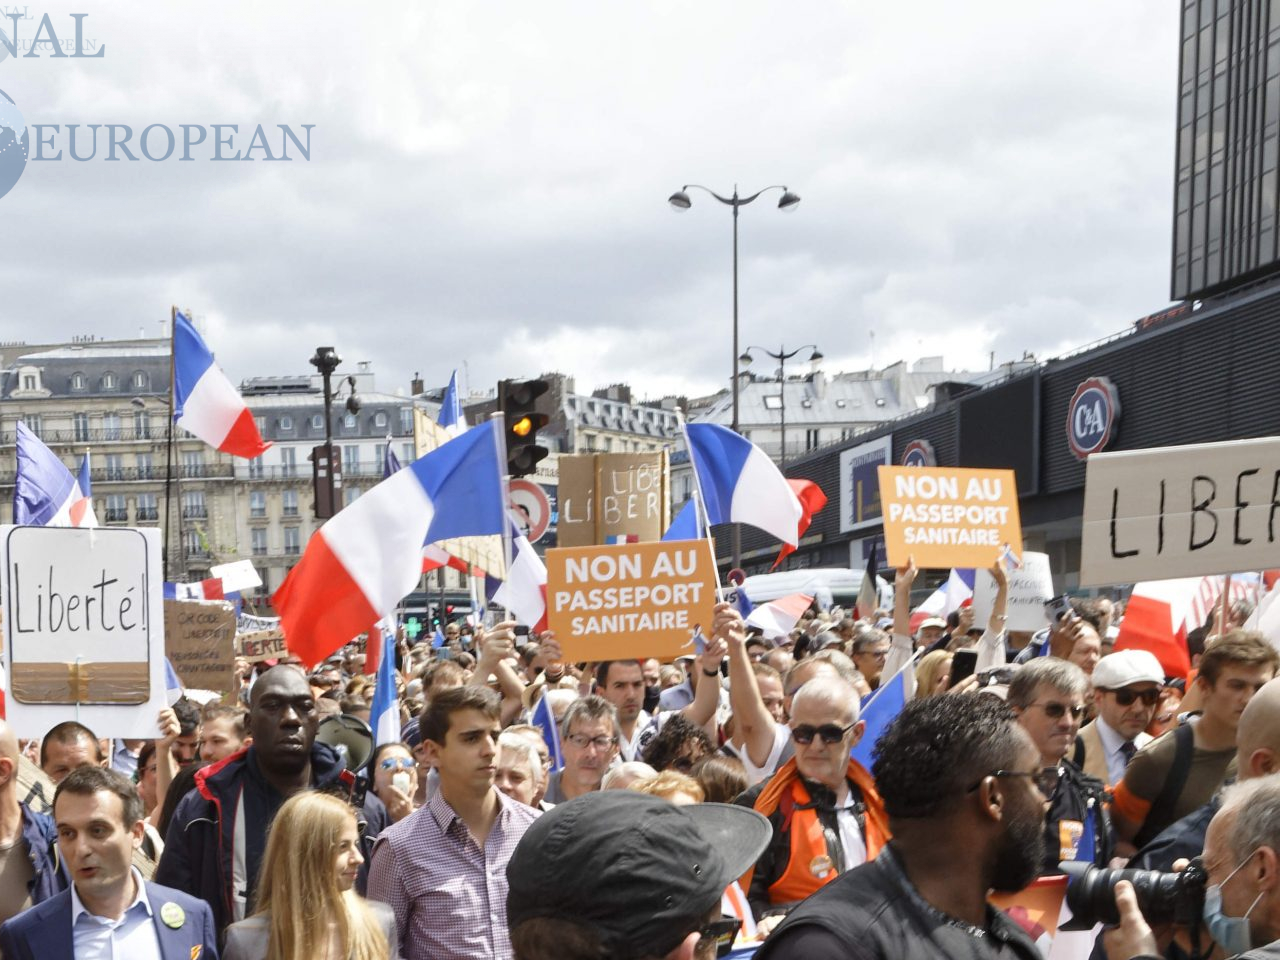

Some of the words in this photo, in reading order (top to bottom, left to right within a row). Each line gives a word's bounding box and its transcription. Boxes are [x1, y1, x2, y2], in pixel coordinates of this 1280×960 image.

[1075, 402, 1105, 438] C&A
[895, 475, 957, 500] NON
[965, 478, 1002, 501] AU
[888, 503, 1009, 526] PASSEPORT
[904, 526, 1000, 546] SANITAIRE
[565, 553, 642, 584] NON
[650, 549, 698, 578] AU
[14, 562, 147, 633] Liberté!
[555, 582, 704, 613] PASSEPORT
[571, 610, 689, 636] SANITAIRE
